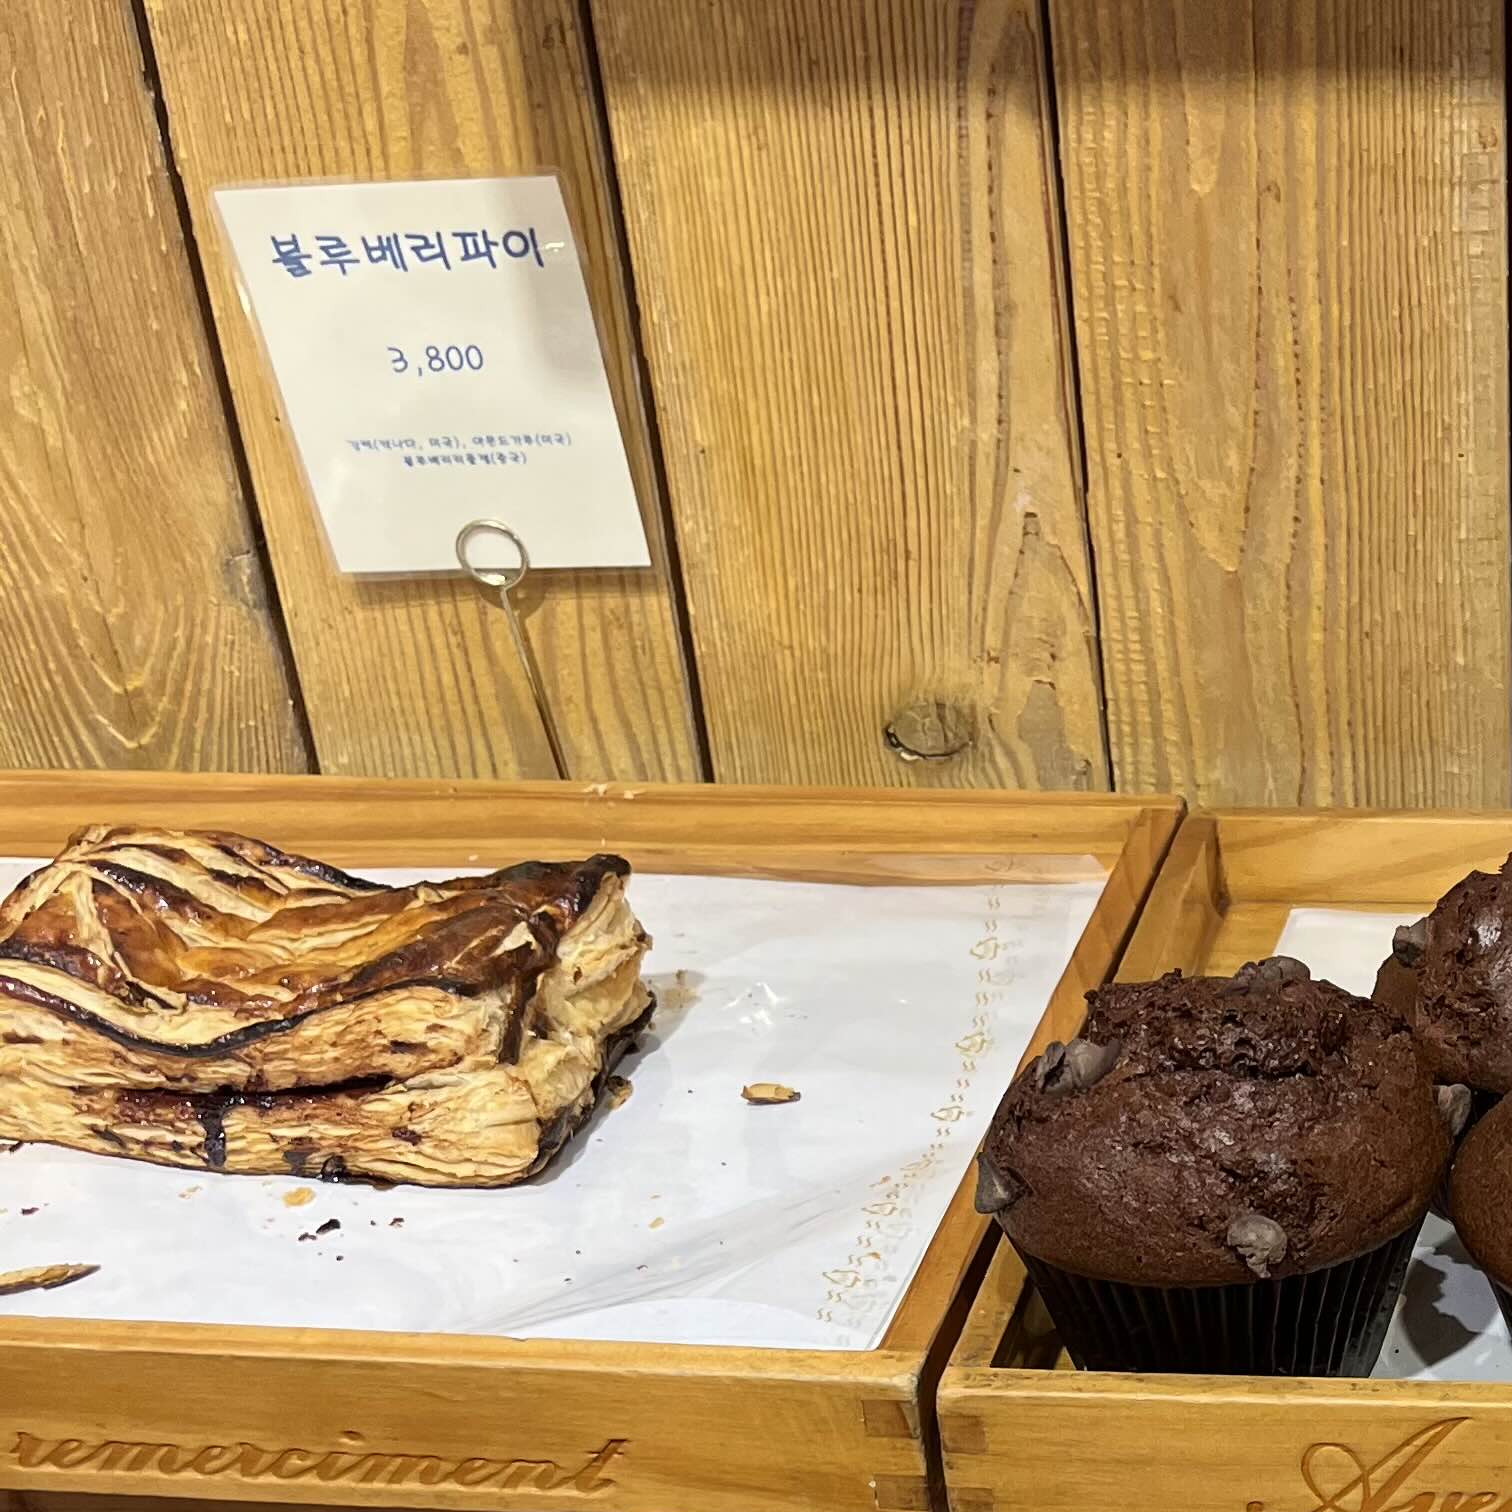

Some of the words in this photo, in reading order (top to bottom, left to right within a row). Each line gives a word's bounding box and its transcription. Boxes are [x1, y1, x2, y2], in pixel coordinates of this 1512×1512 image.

[271, 227, 545, 277] 블루베리파이
[387, 344, 484, 376] 3,800
[10, 1429, 633, 1497] remerciment
